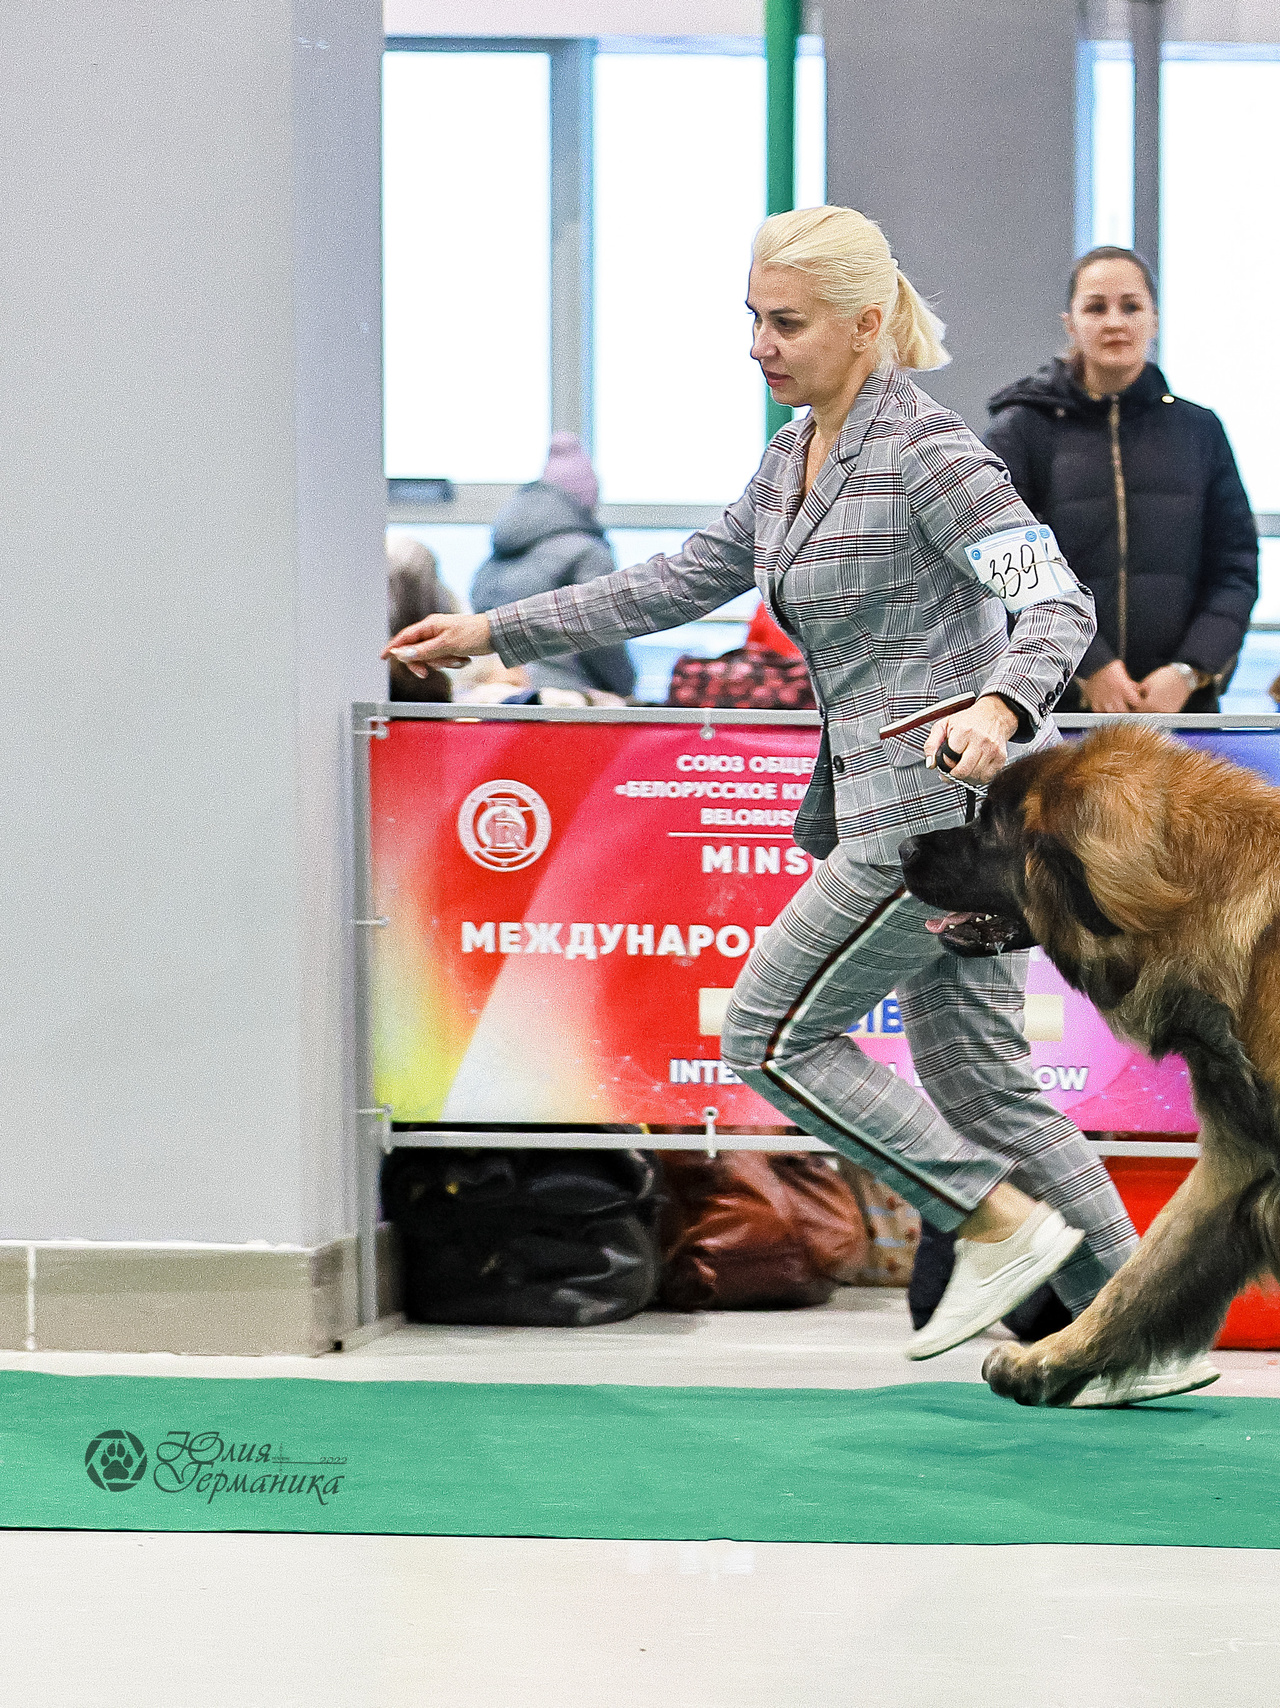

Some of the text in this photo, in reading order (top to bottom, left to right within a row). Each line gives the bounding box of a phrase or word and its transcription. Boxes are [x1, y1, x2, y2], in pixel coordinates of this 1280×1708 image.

[676, 754, 745, 772] СОЮЗ
[461, 921, 768, 960] МЕЖДУНАРО
[846, 998, 905, 1033] IB
[670, 1059, 745, 1085] INTE
